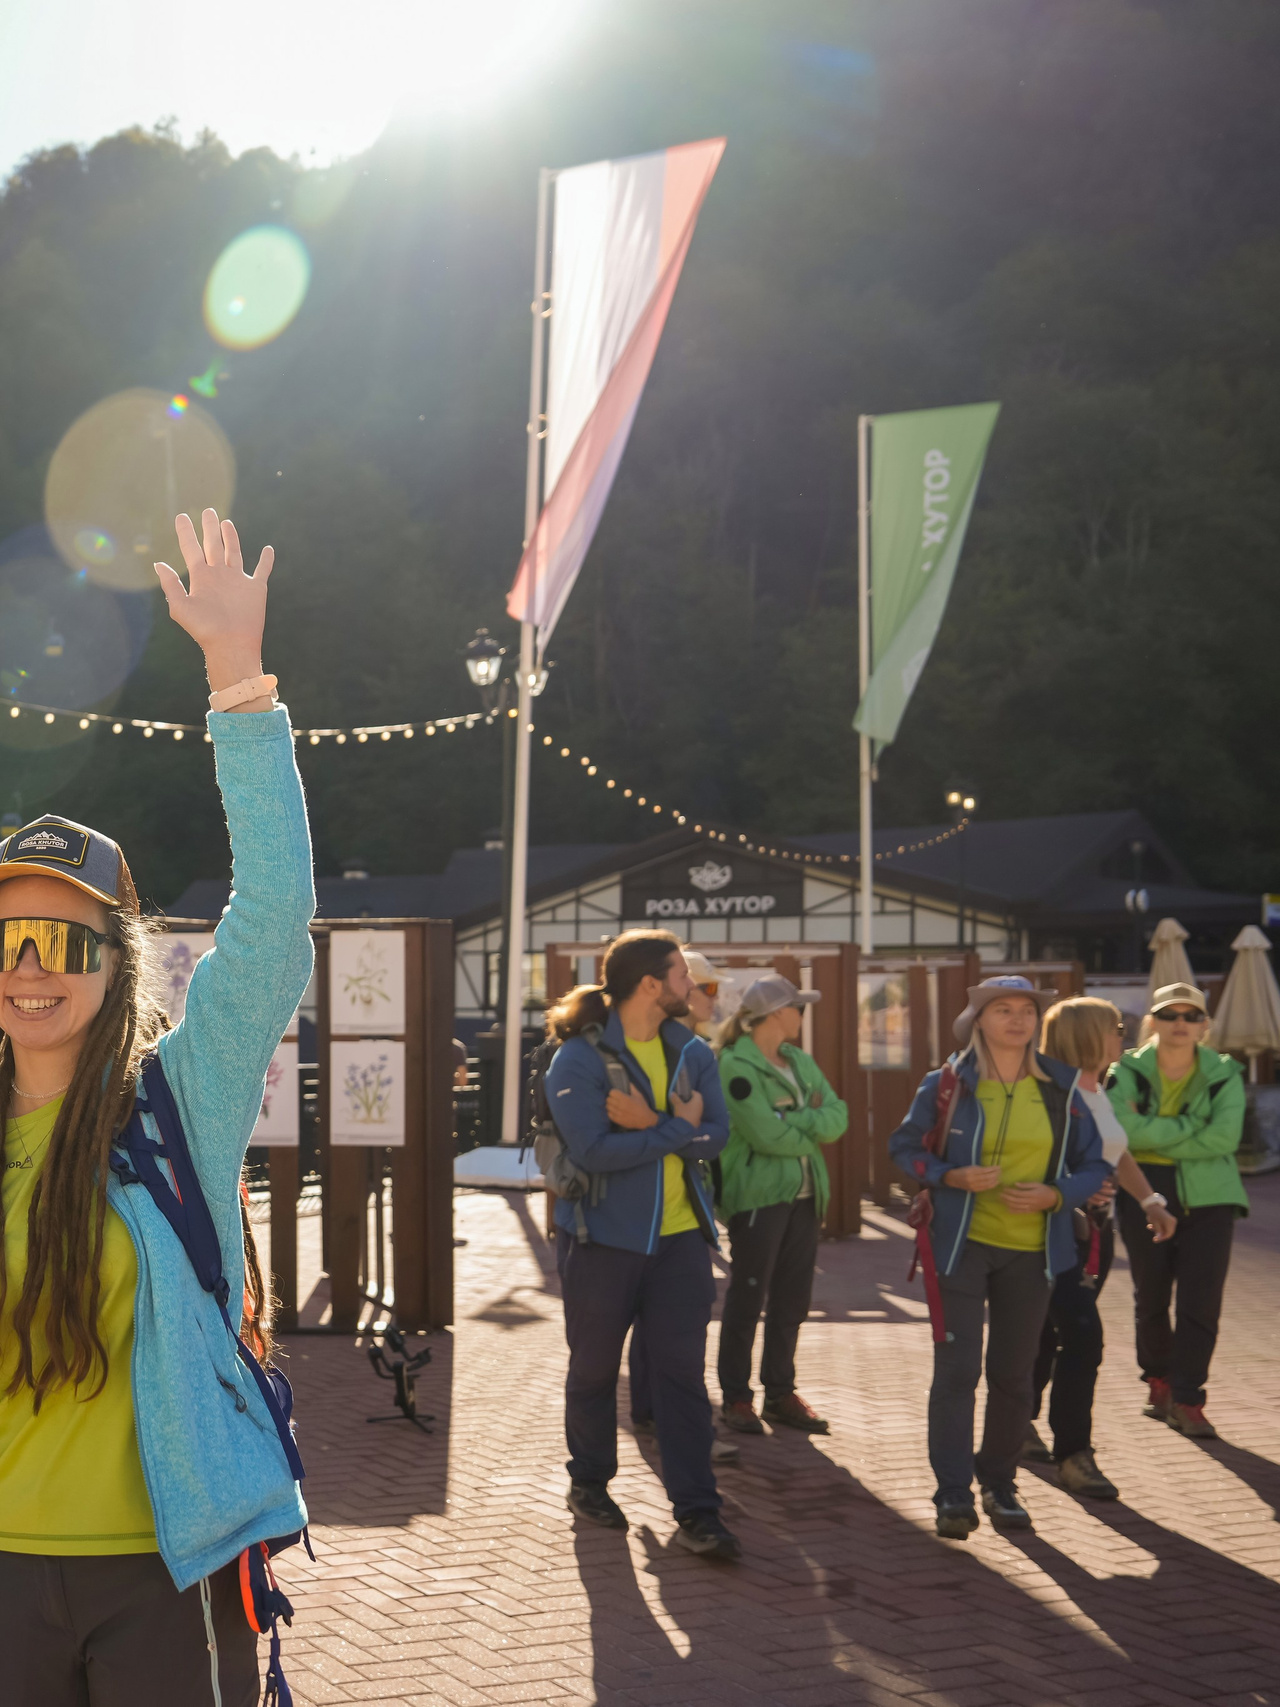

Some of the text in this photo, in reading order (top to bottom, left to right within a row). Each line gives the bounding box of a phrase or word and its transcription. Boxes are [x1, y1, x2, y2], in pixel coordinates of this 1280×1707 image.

[921, 449, 951, 547] ХУТОР
[645, 895, 776, 917] РОЗА ХУТОР
